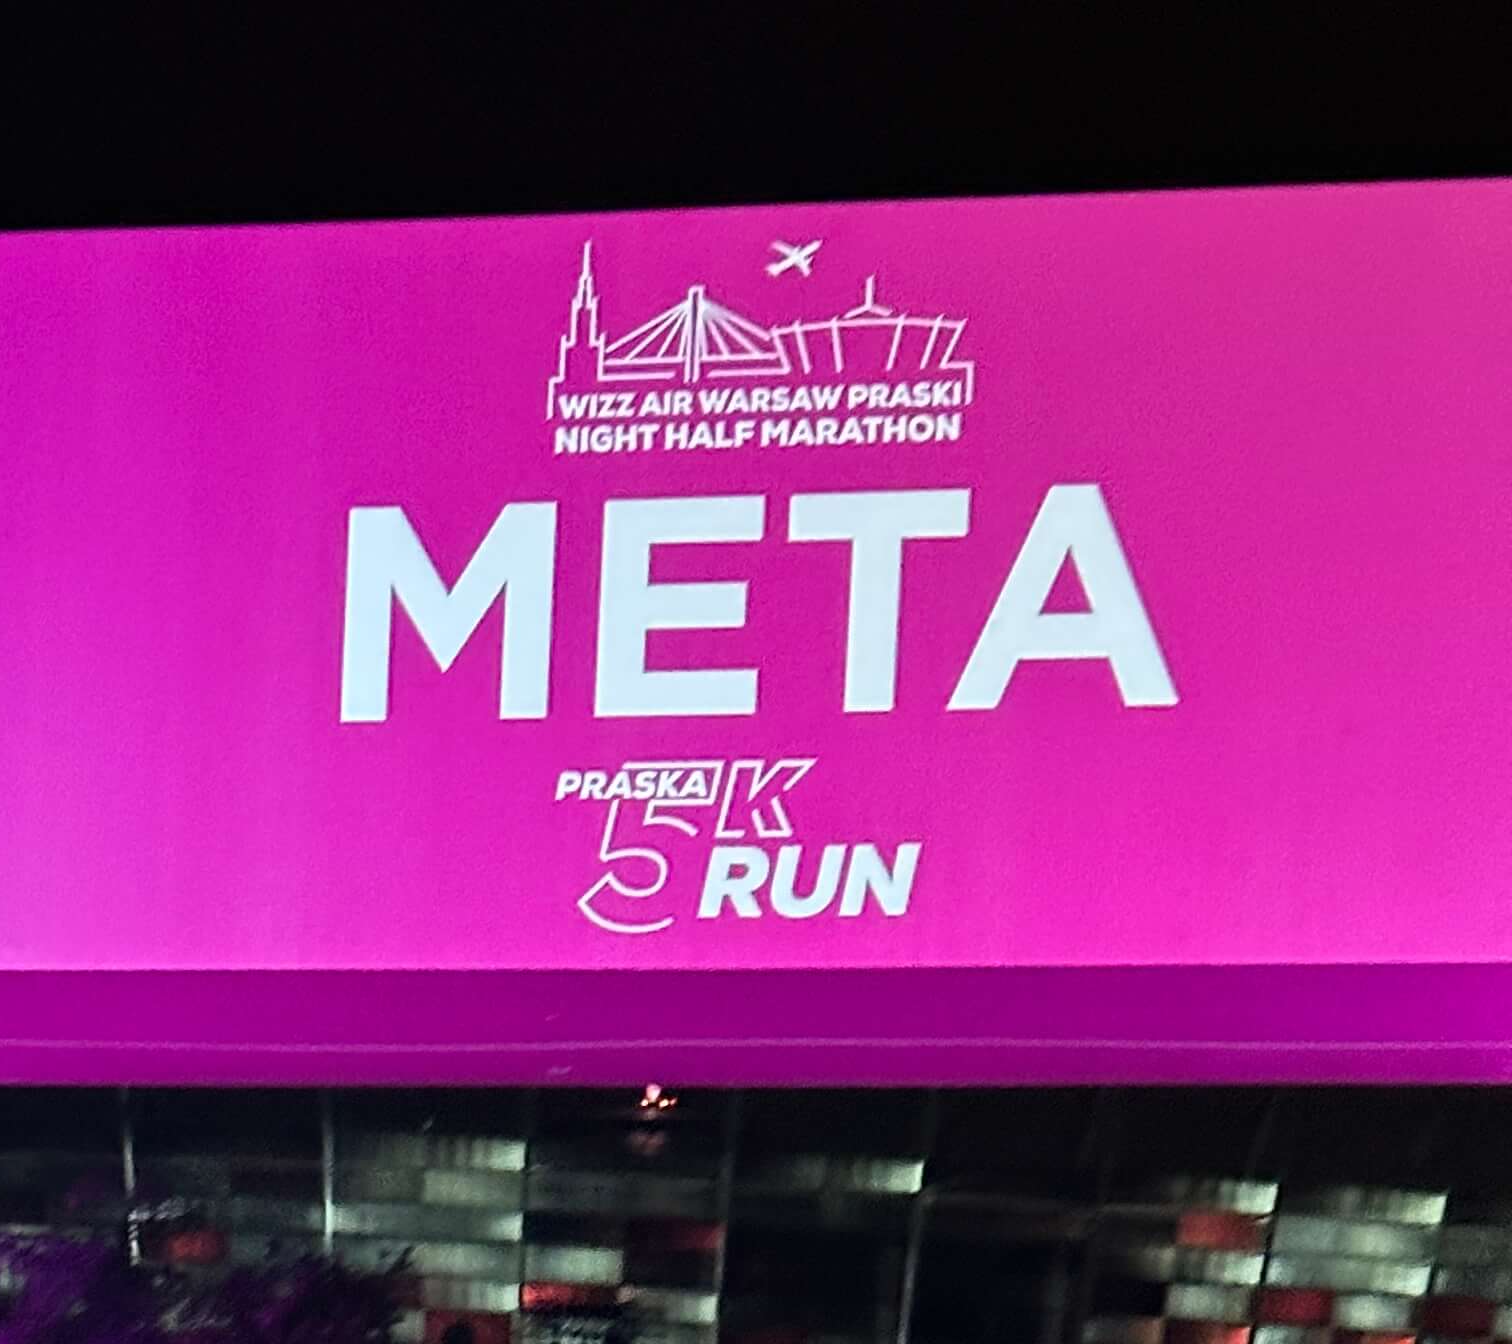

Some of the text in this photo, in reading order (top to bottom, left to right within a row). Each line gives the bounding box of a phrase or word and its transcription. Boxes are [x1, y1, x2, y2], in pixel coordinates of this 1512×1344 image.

[558, 379, 962, 420] WIZZ AIR WARSAW PRASKI
[553, 413, 961, 455] NIGHT HALF MARATHON
[340, 483, 1180, 724] META
[555, 770, 709, 801] PRASKA
[695, 842, 922, 919] RUN
